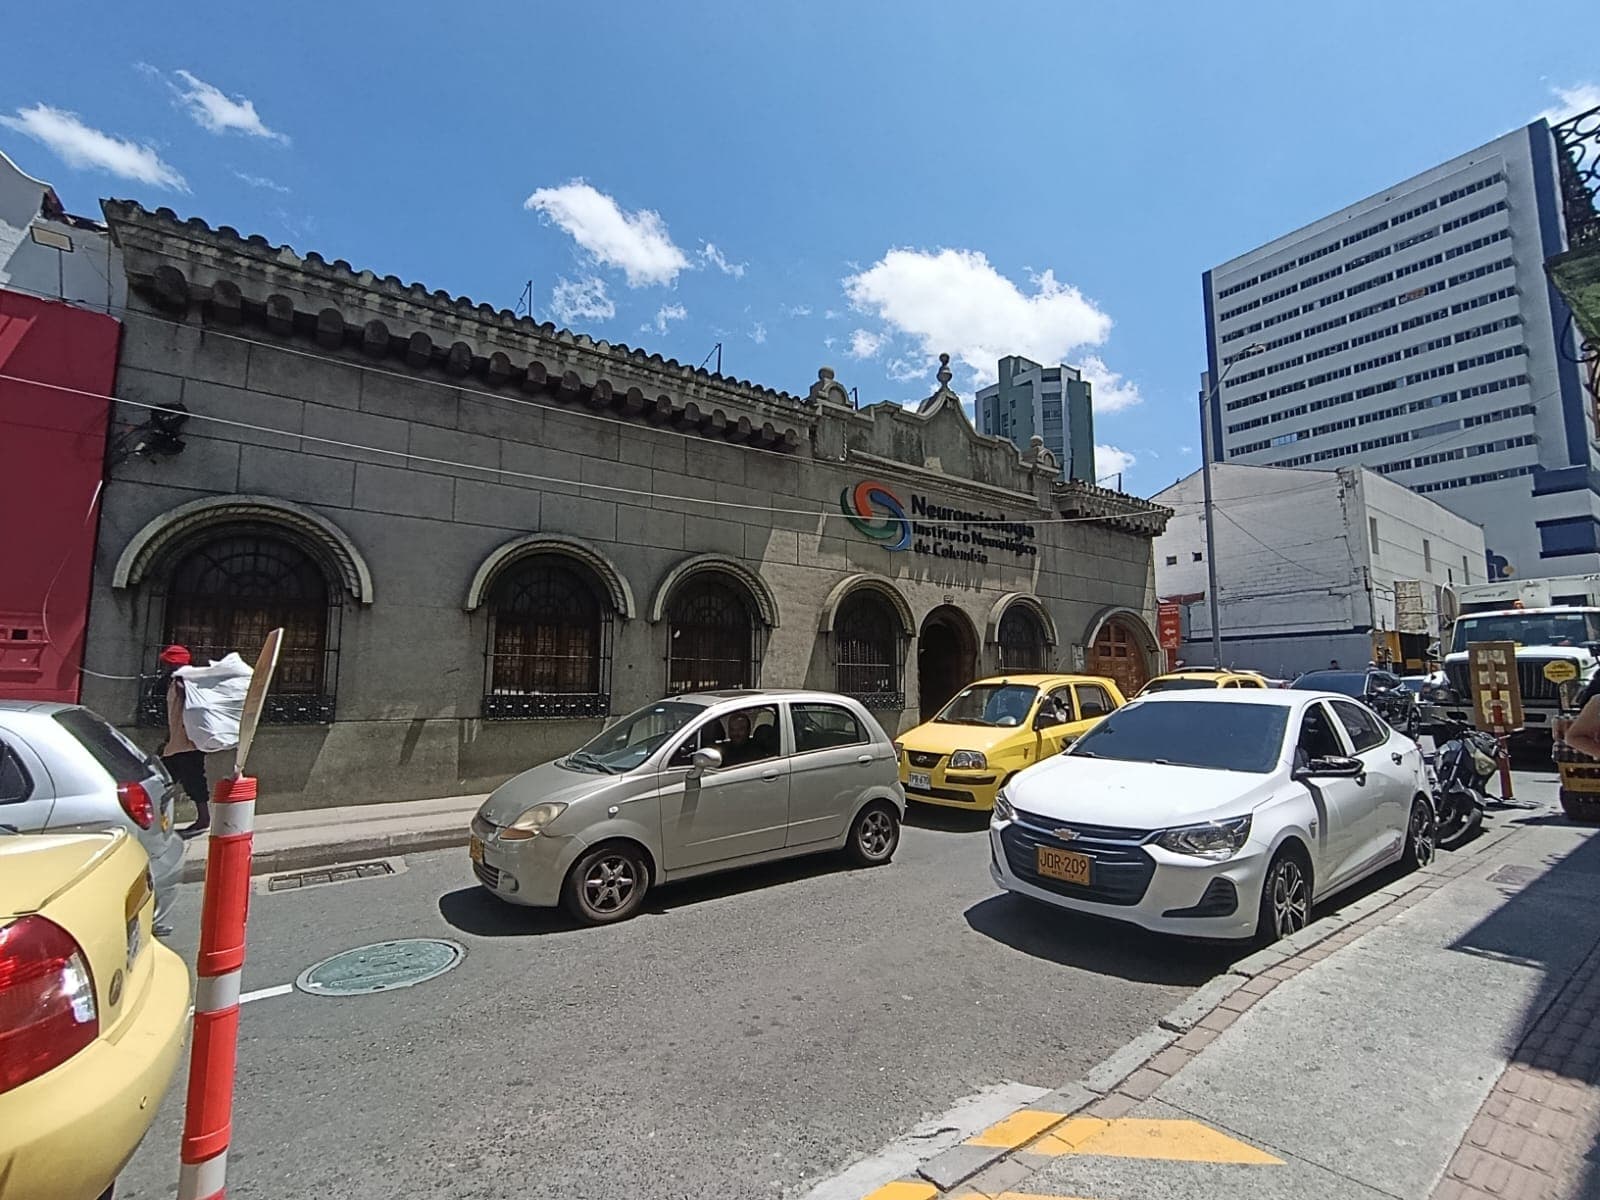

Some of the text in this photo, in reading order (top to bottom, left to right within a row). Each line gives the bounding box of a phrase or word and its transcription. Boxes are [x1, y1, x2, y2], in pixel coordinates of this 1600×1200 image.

[912, 521, 1037, 557] Instituto Neurológico
[914, 538, 988, 565] de Colombia
